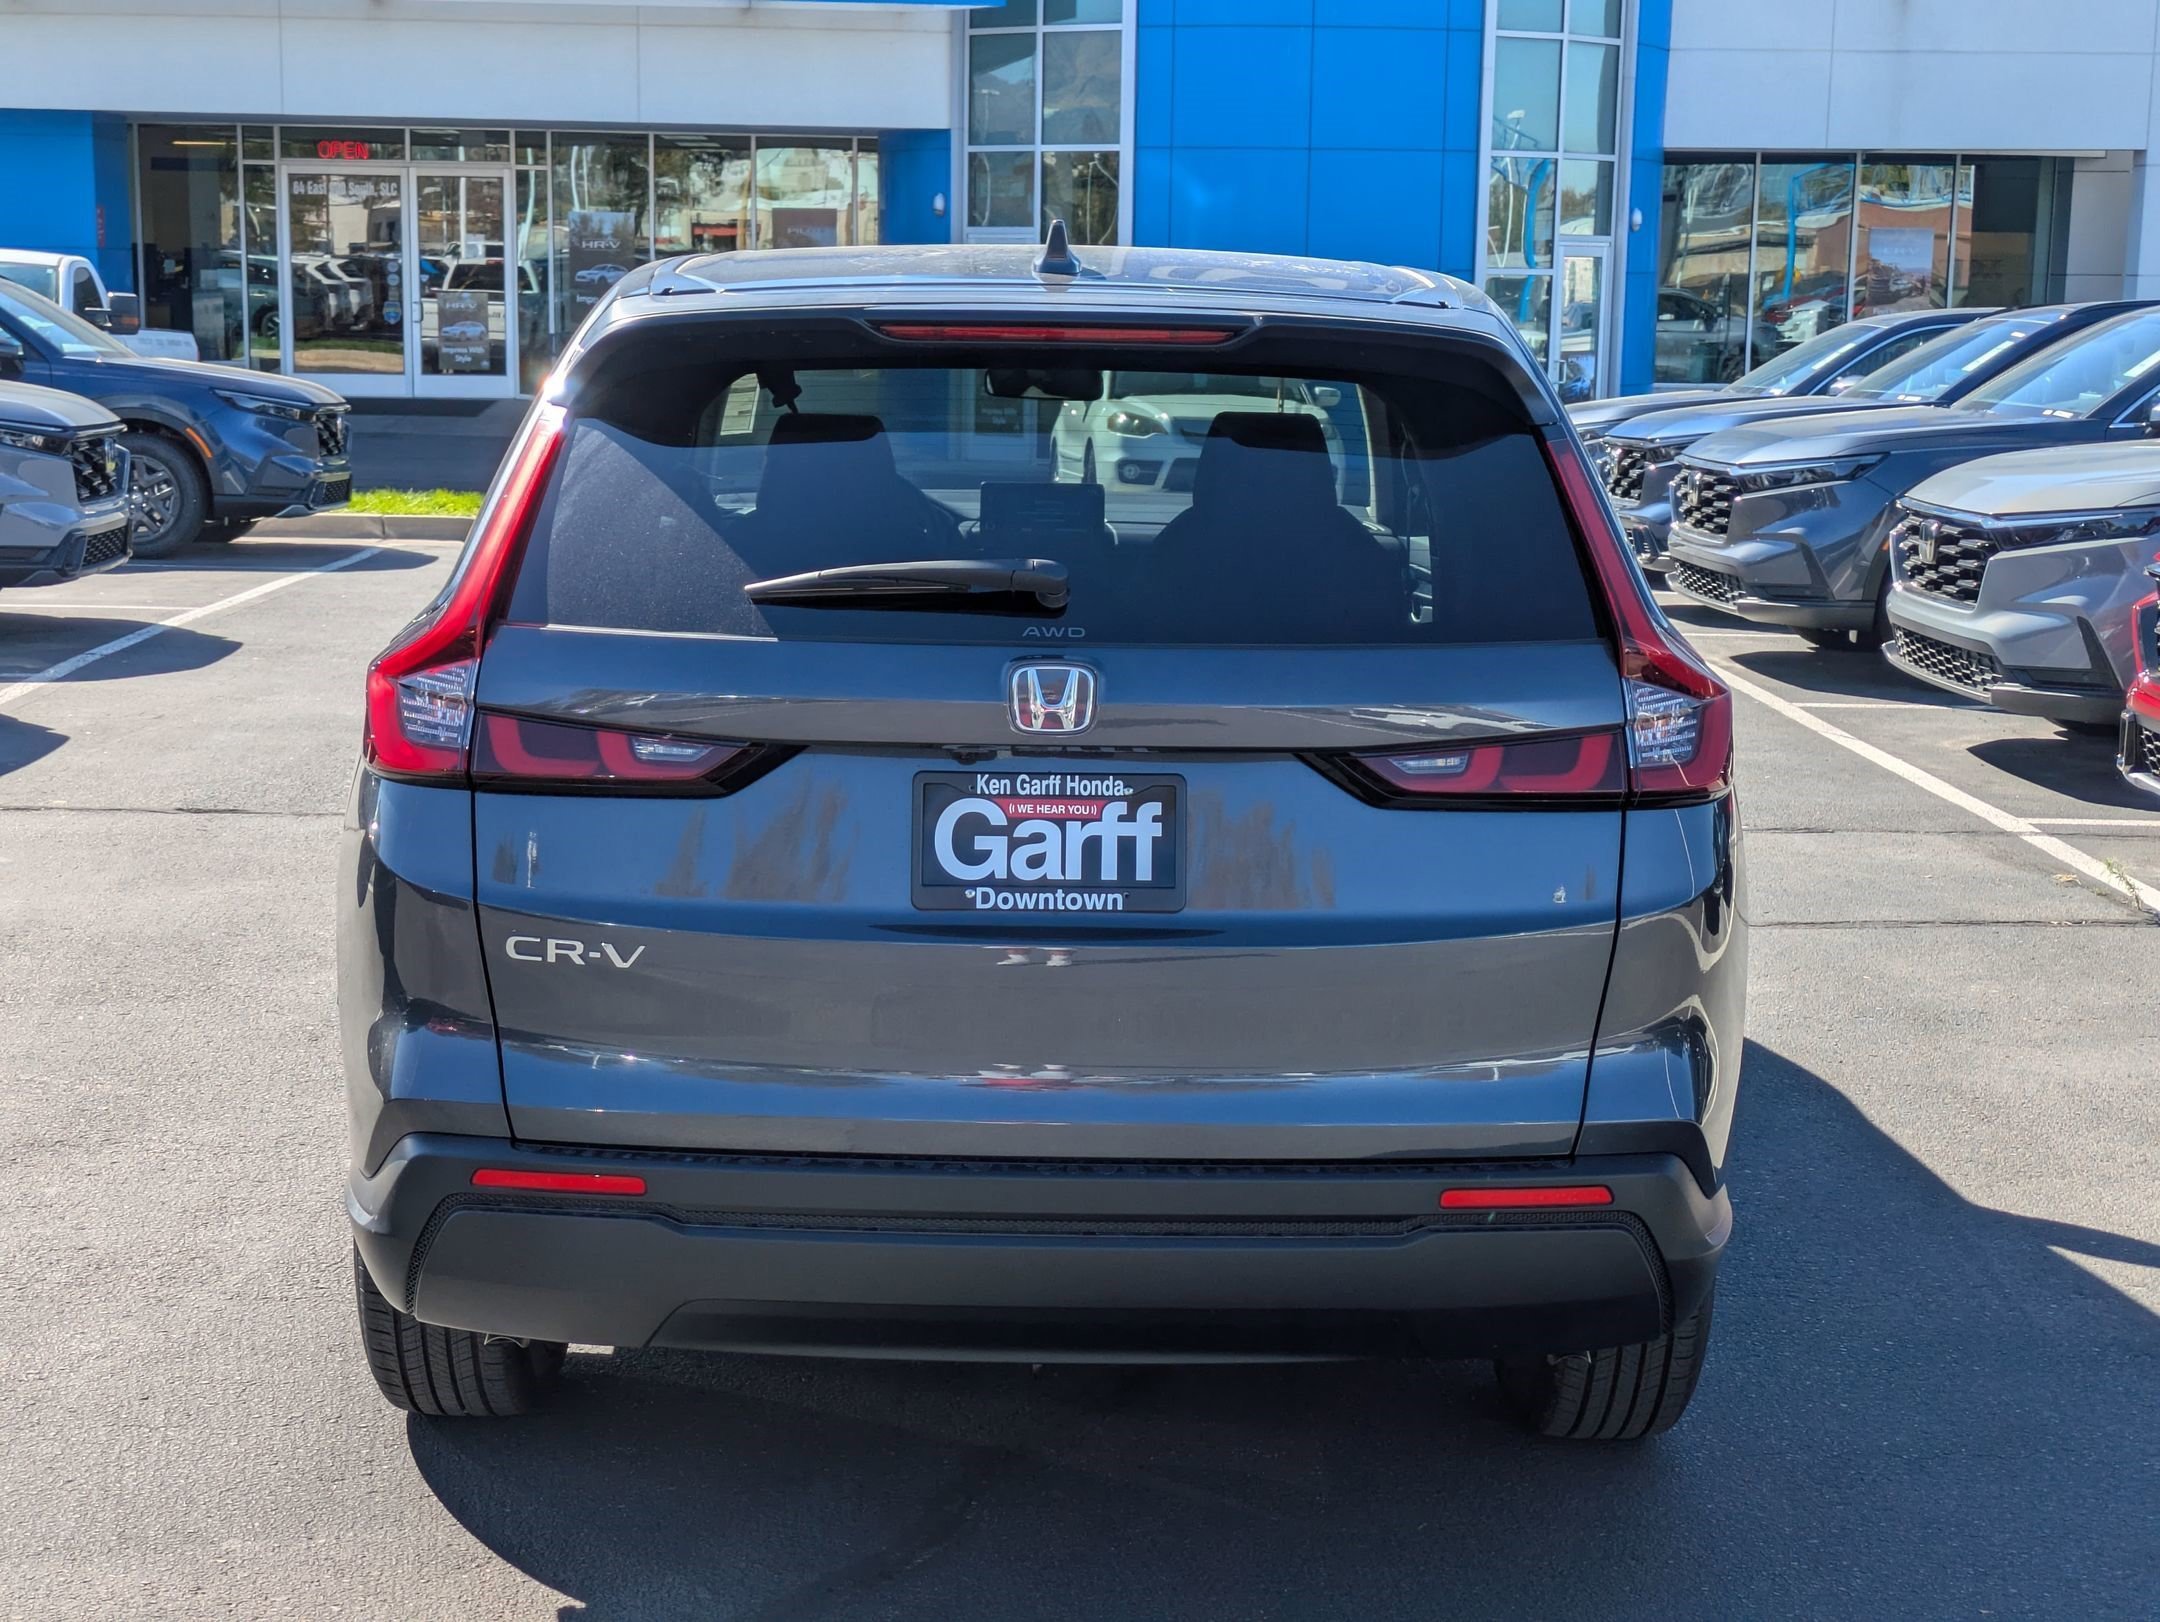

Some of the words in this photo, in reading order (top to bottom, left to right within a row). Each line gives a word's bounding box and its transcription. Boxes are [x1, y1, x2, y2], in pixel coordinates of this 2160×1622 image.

[317, 140, 369, 160] OPEN
[307, 181, 327, 195] East
[380, 182, 398, 196] SLC
[1022, 626, 1086, 638] AWD
[976, 774, 1010, 795] Ken
[1016, 774, 1062, 796] Garff
[1066, 775, 1125, 797] Honda
[1017, 804, 1034, 814] WE
[1036, 804, 1066, 815] HEAR
[1067, 804, 1090, 815] YOU
[934, 797, 1163, 881] Garff
[975, 887, 1123, 911] Downtown
[505, 936, 646, 968] CR-V
